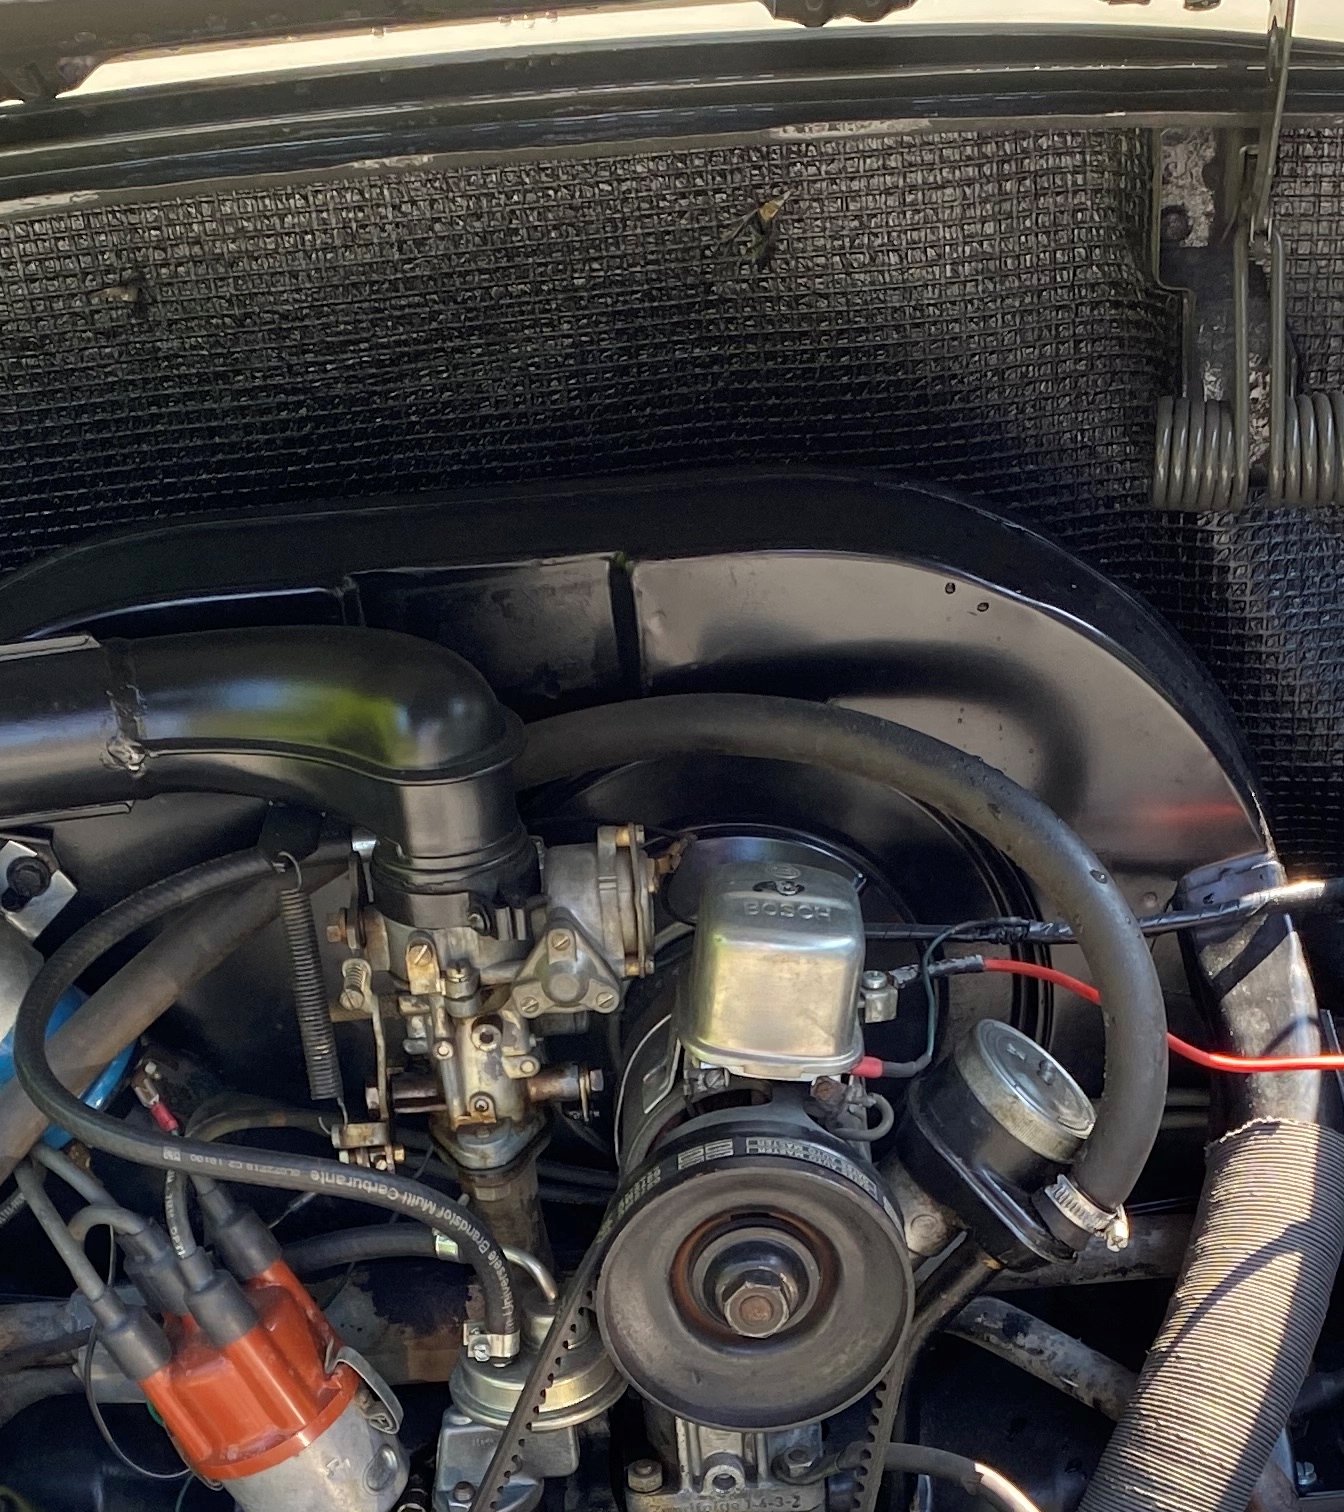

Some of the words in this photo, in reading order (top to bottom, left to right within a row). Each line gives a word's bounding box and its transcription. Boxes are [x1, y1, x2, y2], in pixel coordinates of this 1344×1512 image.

[743, 901, 831, 921] BOSCH
[310, 1169, 399, 1200] Carburante
[401, 1191, 437, 1215] Multi
[435, 1205, 491, 1255] Brandstof
